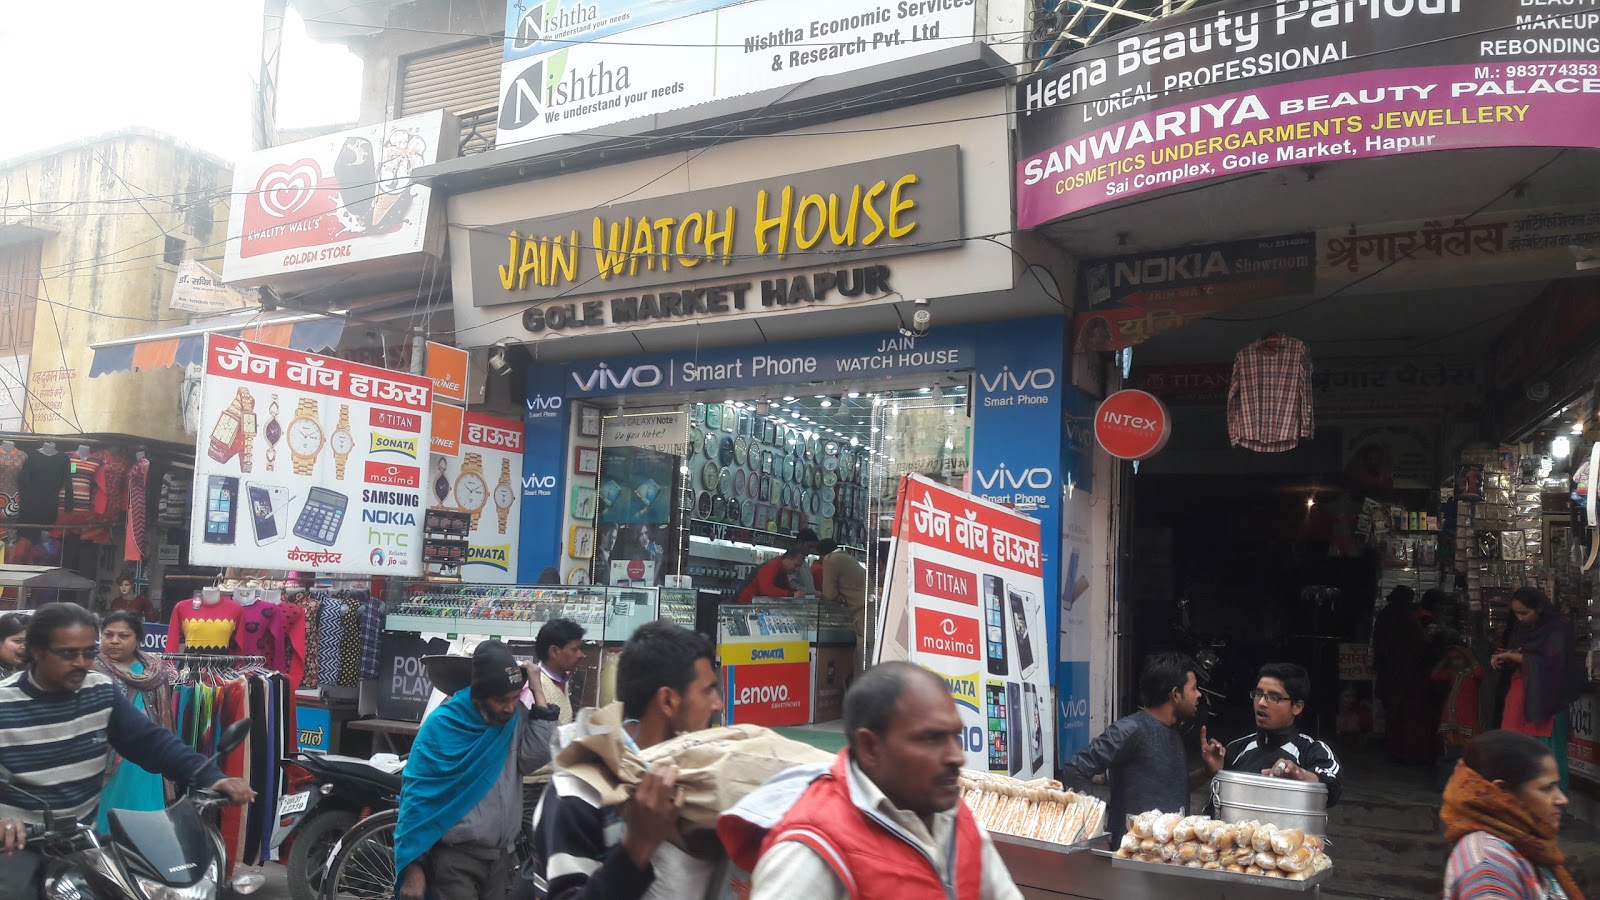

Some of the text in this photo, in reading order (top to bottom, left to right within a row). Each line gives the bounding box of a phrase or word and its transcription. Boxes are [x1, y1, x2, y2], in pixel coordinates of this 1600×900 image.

[523, 3, 597, 45] Nishtha
[554, 24, 591, 40] understand
[593, 19, 609, 33] your
[610, 12, 631, 24] needs
[744, 28, 804, 54] Nishtha
[809, 8, 891, 39] Economic
[1516, 13, 1600, 31] MAKEUP
[771, 21, 940, 72] & Research Pvt. Ltd
[1480, 37, 1600, 57] REBONDING
[1026, 58, 1107, 116] Heena
[1117, 9, 1260, 77] Beauty
[1506, 63, 1600, 78] 983774353
[513, 61, 633, 125] Nishtha
[1083, 40, 1357, 123] L'OREAL PROFESSIONAL
[545, 82, 685, 123] We understand your needs
[1024, 77, 1600, 186] SANWARIYA BEAUTY PALACE
[1055, 104, 1531, 196] COSMETICS UNDERGARMENTS JEWELLERY
[1105, 133, 1437, 197] Sai Complex, Gole Market, Hapur
[247, 218, 320, 242] KWALITY WALL'S
[498, 172, 918, 290] JAIN WATCH HOUSE
[283, 243, 352, 267] GOLDEN STORE
[1113, 250, 1232, 289] NOKIA
[1234, 254, 1309, 273] Showroom
[521, 265, 892, 332] GOLE MARKET HAPUR
[877, 336, 915, 353] JAIN
[836, 348, 959, 372] WATCH HOUSE
[215, 341, 279, 380] जैन
[286, 357, 343, 391] वॉच
[349, 372, 429, 407] हाऊस
[571, 355, 818, 392] vivo Smart Phone
[979, 364, 1056, 392] vivo
[526, 394, 562, 410] vivo
[983, 394, 1049, 407] Smart Phone
[387, 414, 413, 428] TITAN
[627, 416, 656, 427] GALAXY
[656, 416, 673, 425] Note
[375, 436, 415, 452] SONATA
[468, 422, 522, 449] हाऊस
[615, 428, 666, 442] Do you Note?
[370, 473, 414, 487] maxima
[521, 472, 556, 489] vivo
[976, 462, 1053, 490] vivo
[362, 489, 419, 508] SAMSUNG
[538, 488, 551, 496] Phone
[981, 493, 1047, 505] Smart Phone
[361, 509, 416, 527] NOKIA
[910, 490, 1041, 569] जैन वॉच हाऊस
[287, 546, 343, 567] कैलकूलेटर
[467, 546, 505, 561] ONATA
[936, 571, 968, 597] TITAN
[750, 647, 785, 661] SONATA
[923, 636, 975, 656] maxima
[392, 675, 432, 696] PLAY
[733, 683, 789, 706] Lenovo
[946, 678, 976, 698] NATA
[1061, 695, 1087, 719] vivo
[299, 726, 324, 746] वाले
[168, 862, 198, 874] HONDA
